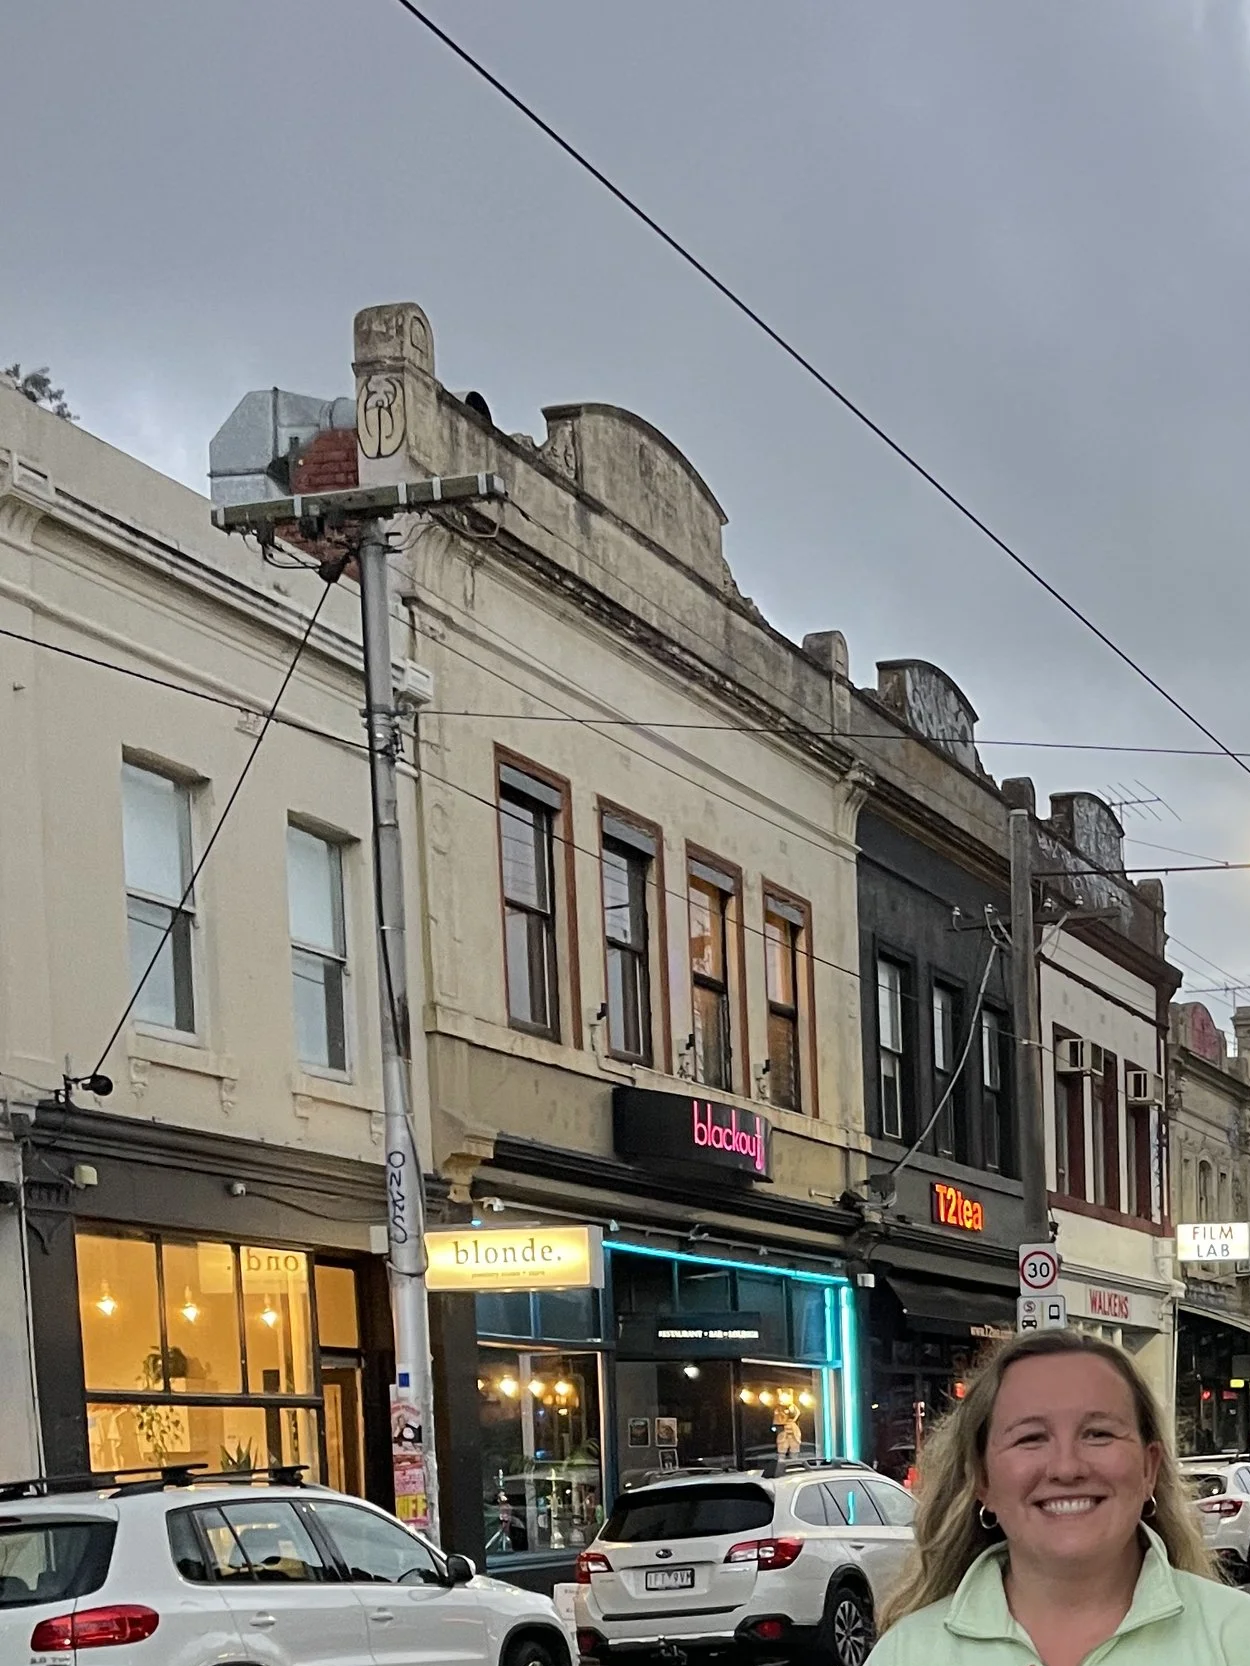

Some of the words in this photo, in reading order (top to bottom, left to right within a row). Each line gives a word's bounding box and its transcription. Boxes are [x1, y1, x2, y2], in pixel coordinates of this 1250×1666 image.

[692, 1100, 763, 1170] blackout
[935, 1184, 983, 1230] T2tea
[1192, 1226, 1234, 1241] FILM
[452, 1238, 562, 1265] blonde.
[1197, 1244, 1230, 1258] LAB
[1028, 1262, 1050, 1279] 30
